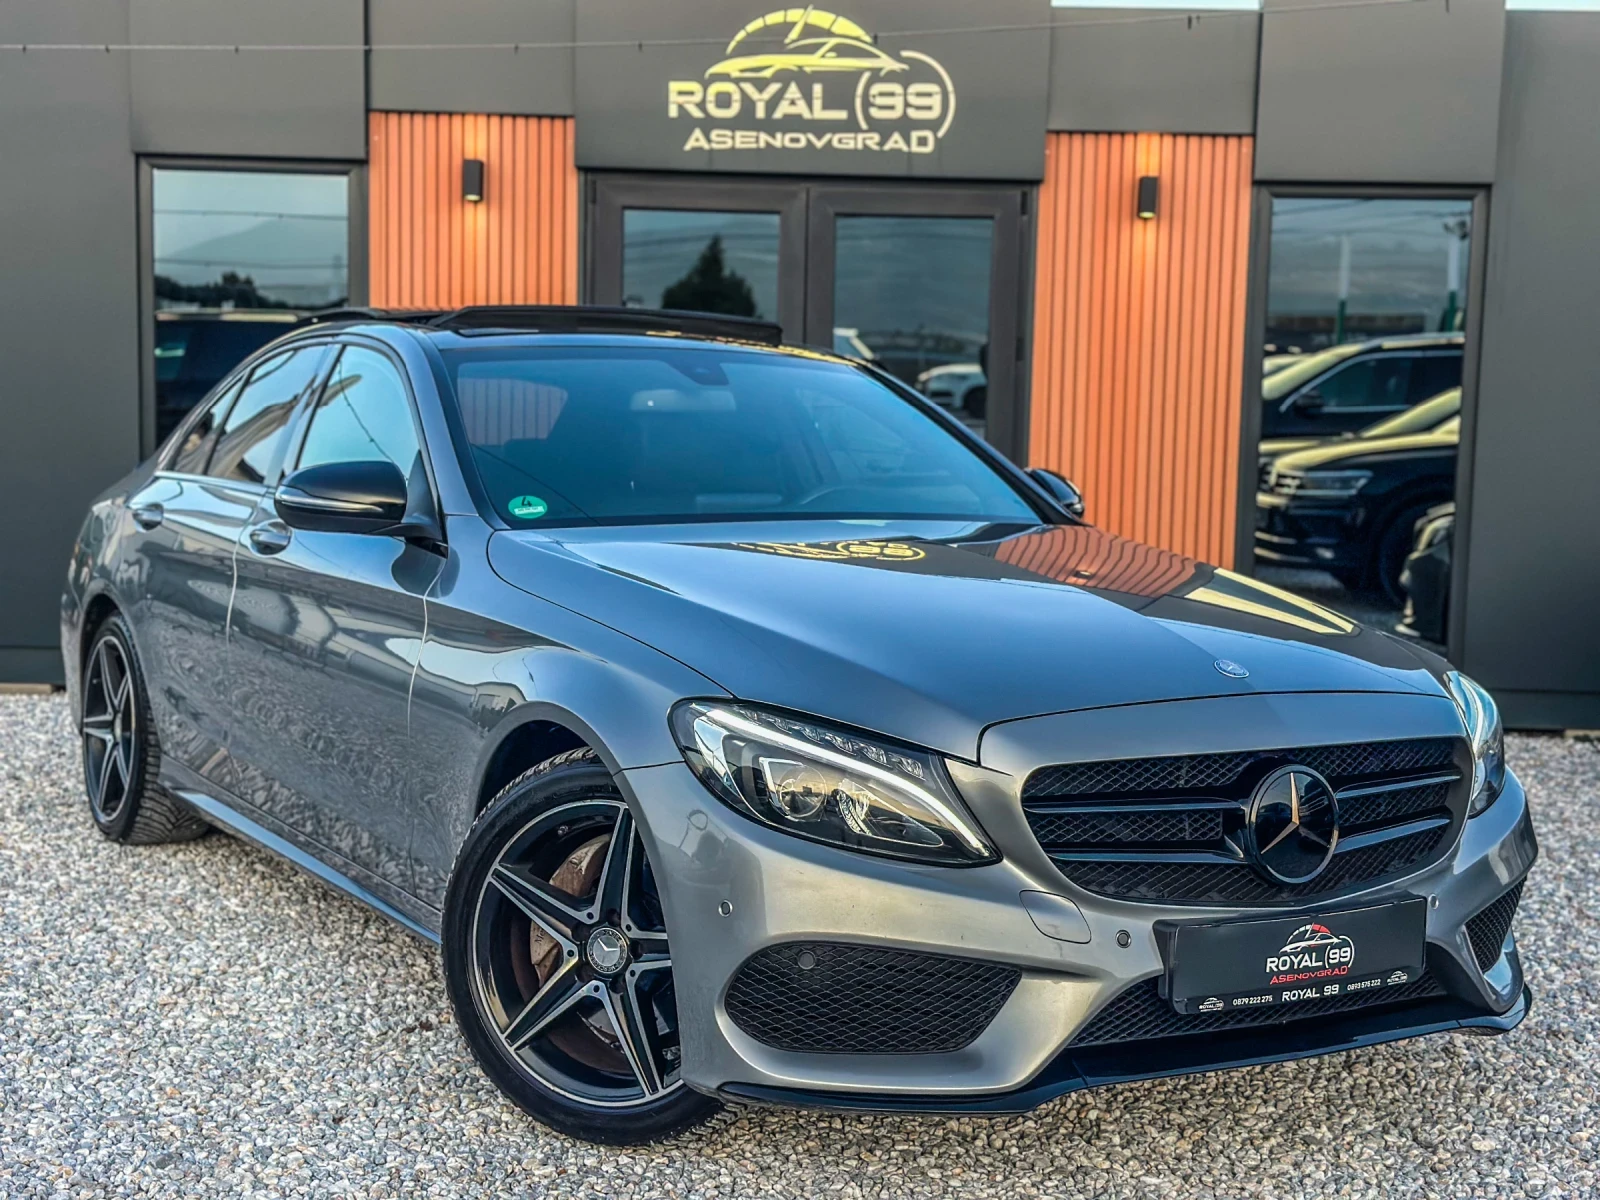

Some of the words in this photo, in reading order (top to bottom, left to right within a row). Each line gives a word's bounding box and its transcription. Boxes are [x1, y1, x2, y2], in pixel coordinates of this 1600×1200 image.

[667, 80, 848, 120] ROYAL
[683, 127, 936, 154] ASENOVGRAD
[1266, 952, 1323, 972] ROYAL
[1269, 965, 1348, 985] ASENOVGRAD
[1281, 988, 1320, 1002] ROYAL
[1323, 984, 1340, 996] 99
